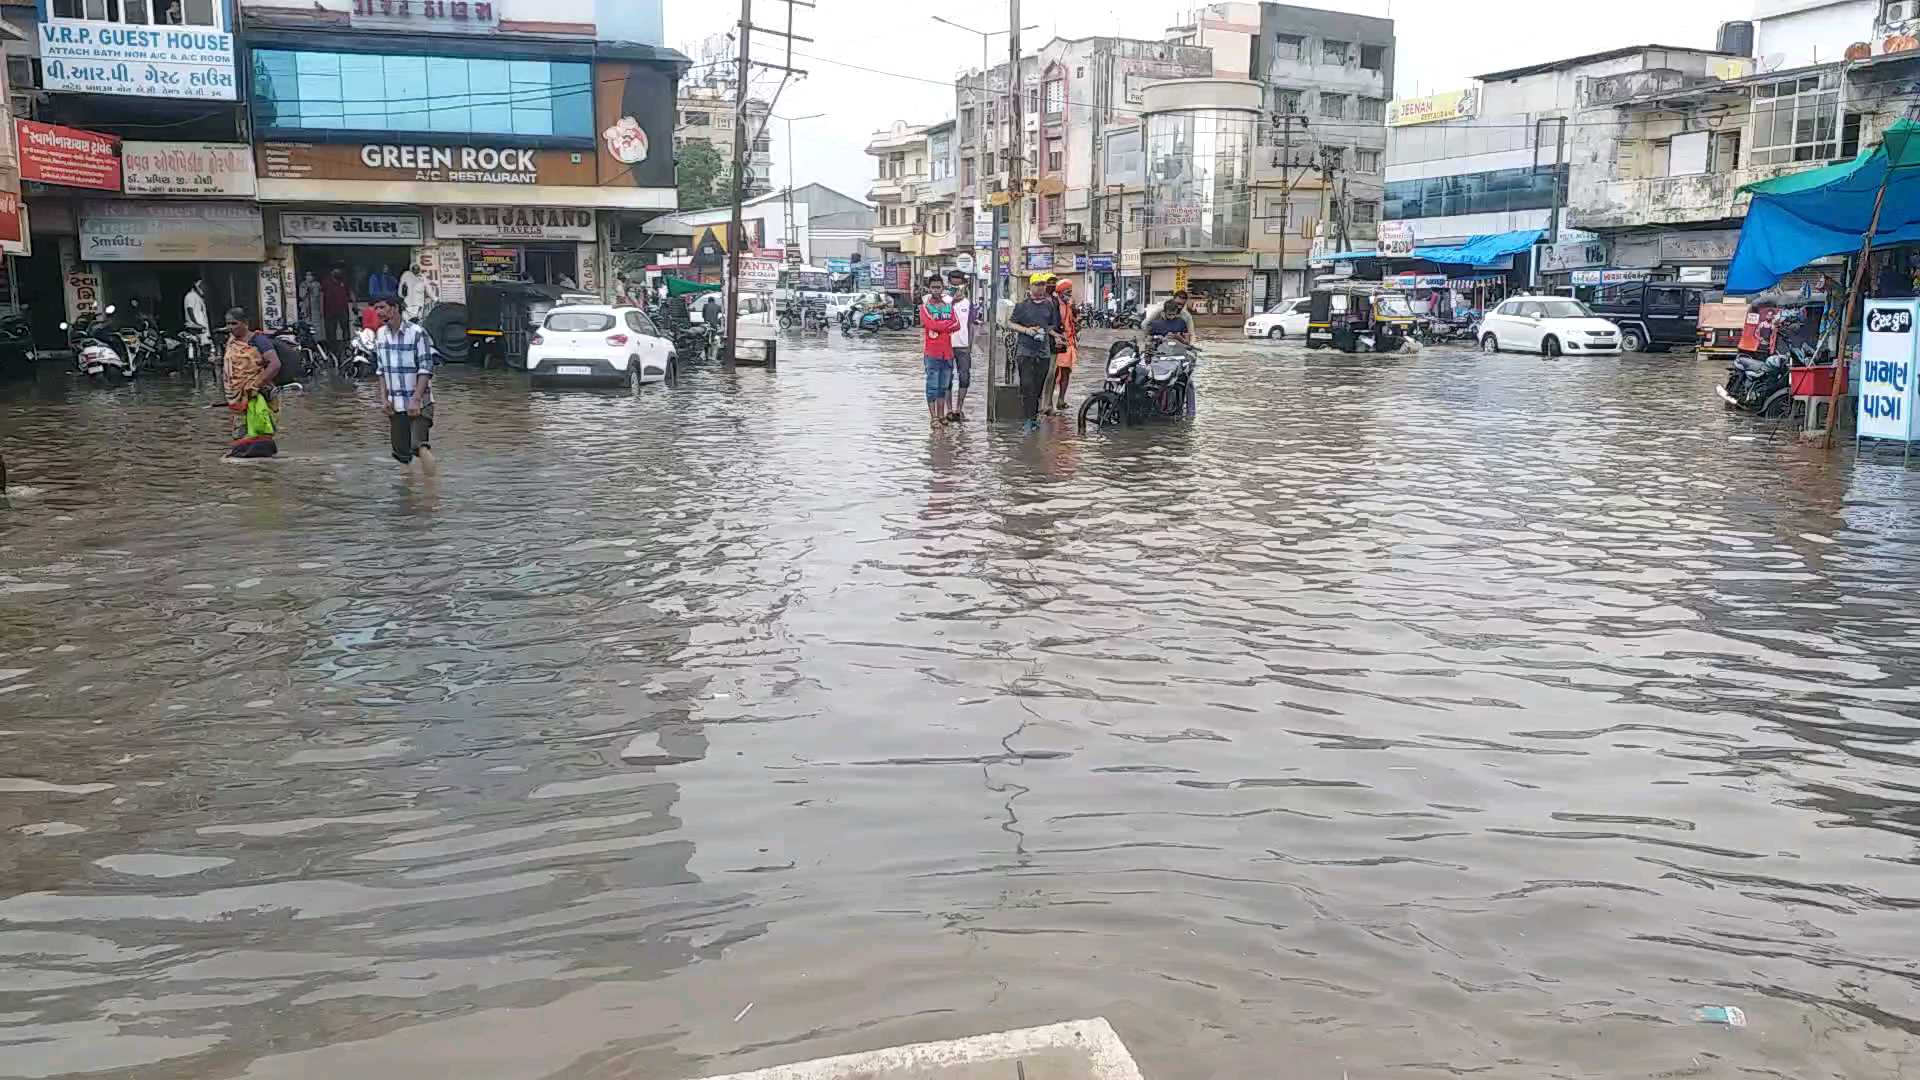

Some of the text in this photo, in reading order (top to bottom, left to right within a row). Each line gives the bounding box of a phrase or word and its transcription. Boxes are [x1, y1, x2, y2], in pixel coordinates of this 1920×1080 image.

[43, 26, 230, 51] V.R.P. GUEST HOUSE
[48, 47, 89, 56] ATTACH
[94, 49, 120, 57] BATH
[124, 50, 146, 58] NON
[200, 55, 230, 63] ROOM
[47, 60, 232, 87] વી.આર.પી. ગેસ્ટ હાઉસ
[1401, 101, 1432, 116] JEENAM
[360, 145, 537, 172] GREEN ROCK
[415, 170, 538, 184] A/C RESTAURANT
[455, 208, 591, 227] SAHJANAND
[497, 226, 542, 234] TRAVELS
